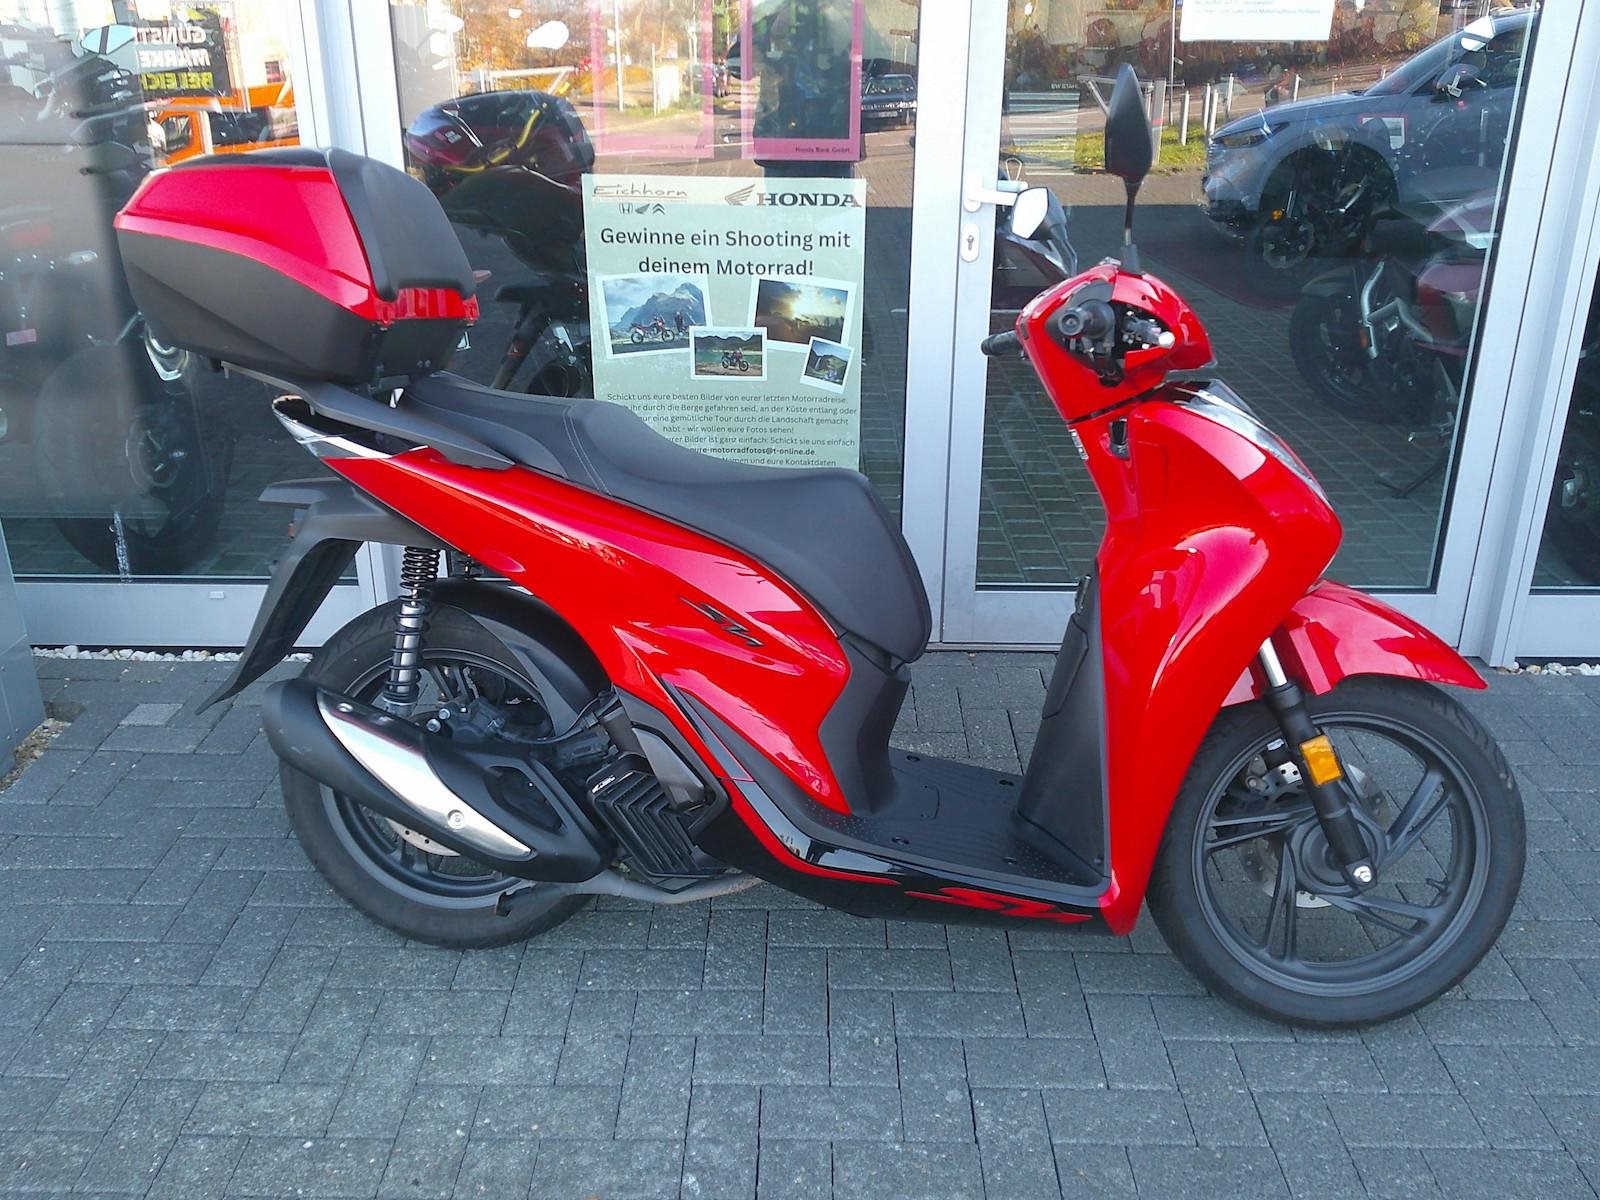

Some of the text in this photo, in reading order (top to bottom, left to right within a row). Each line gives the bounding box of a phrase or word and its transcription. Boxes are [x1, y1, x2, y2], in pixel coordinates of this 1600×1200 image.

[592, 182, 688, 197] Eichhorn
[756, 192, 862, 208] HONDA
[600, 228, 851, 251] Gewinne ein Shooting mit
[638, 257, 814, 275] deinem Motorrad!
[607, 393, 635, 401] Schickt
[673, 393, 698, 401] besten
[700, 393, 722, 401] Bilder
[763, 394, 789, 402] letzten
[667, 404, 679, 412] die
[681, 404, 702, 413] Berge
[705, 404, 738, 413] gefahren
[740, 405, 758, 413] seid,
[771, 405, 784, 413] der
[786, 405, 807, 413] Küste
[808, 407, 837, 415] entlang
[839, 407, 857, 415] oder
[670, 415, 713, 423] gemütliche
[772, 416, 814, 424] Landschaft
[815, 417, 848, 426] gemacht
[663, 425, 680, 433] habt
[700, 425, 726, 433] wollen
[746, 426, 767, 434] Fotos
[769, 426, 794, 434] sehen!
[799, 437, 809, 445] sie
[827, 438, 855, 447] einfach
[785, 459, 837, 467] Kontaktdaten
